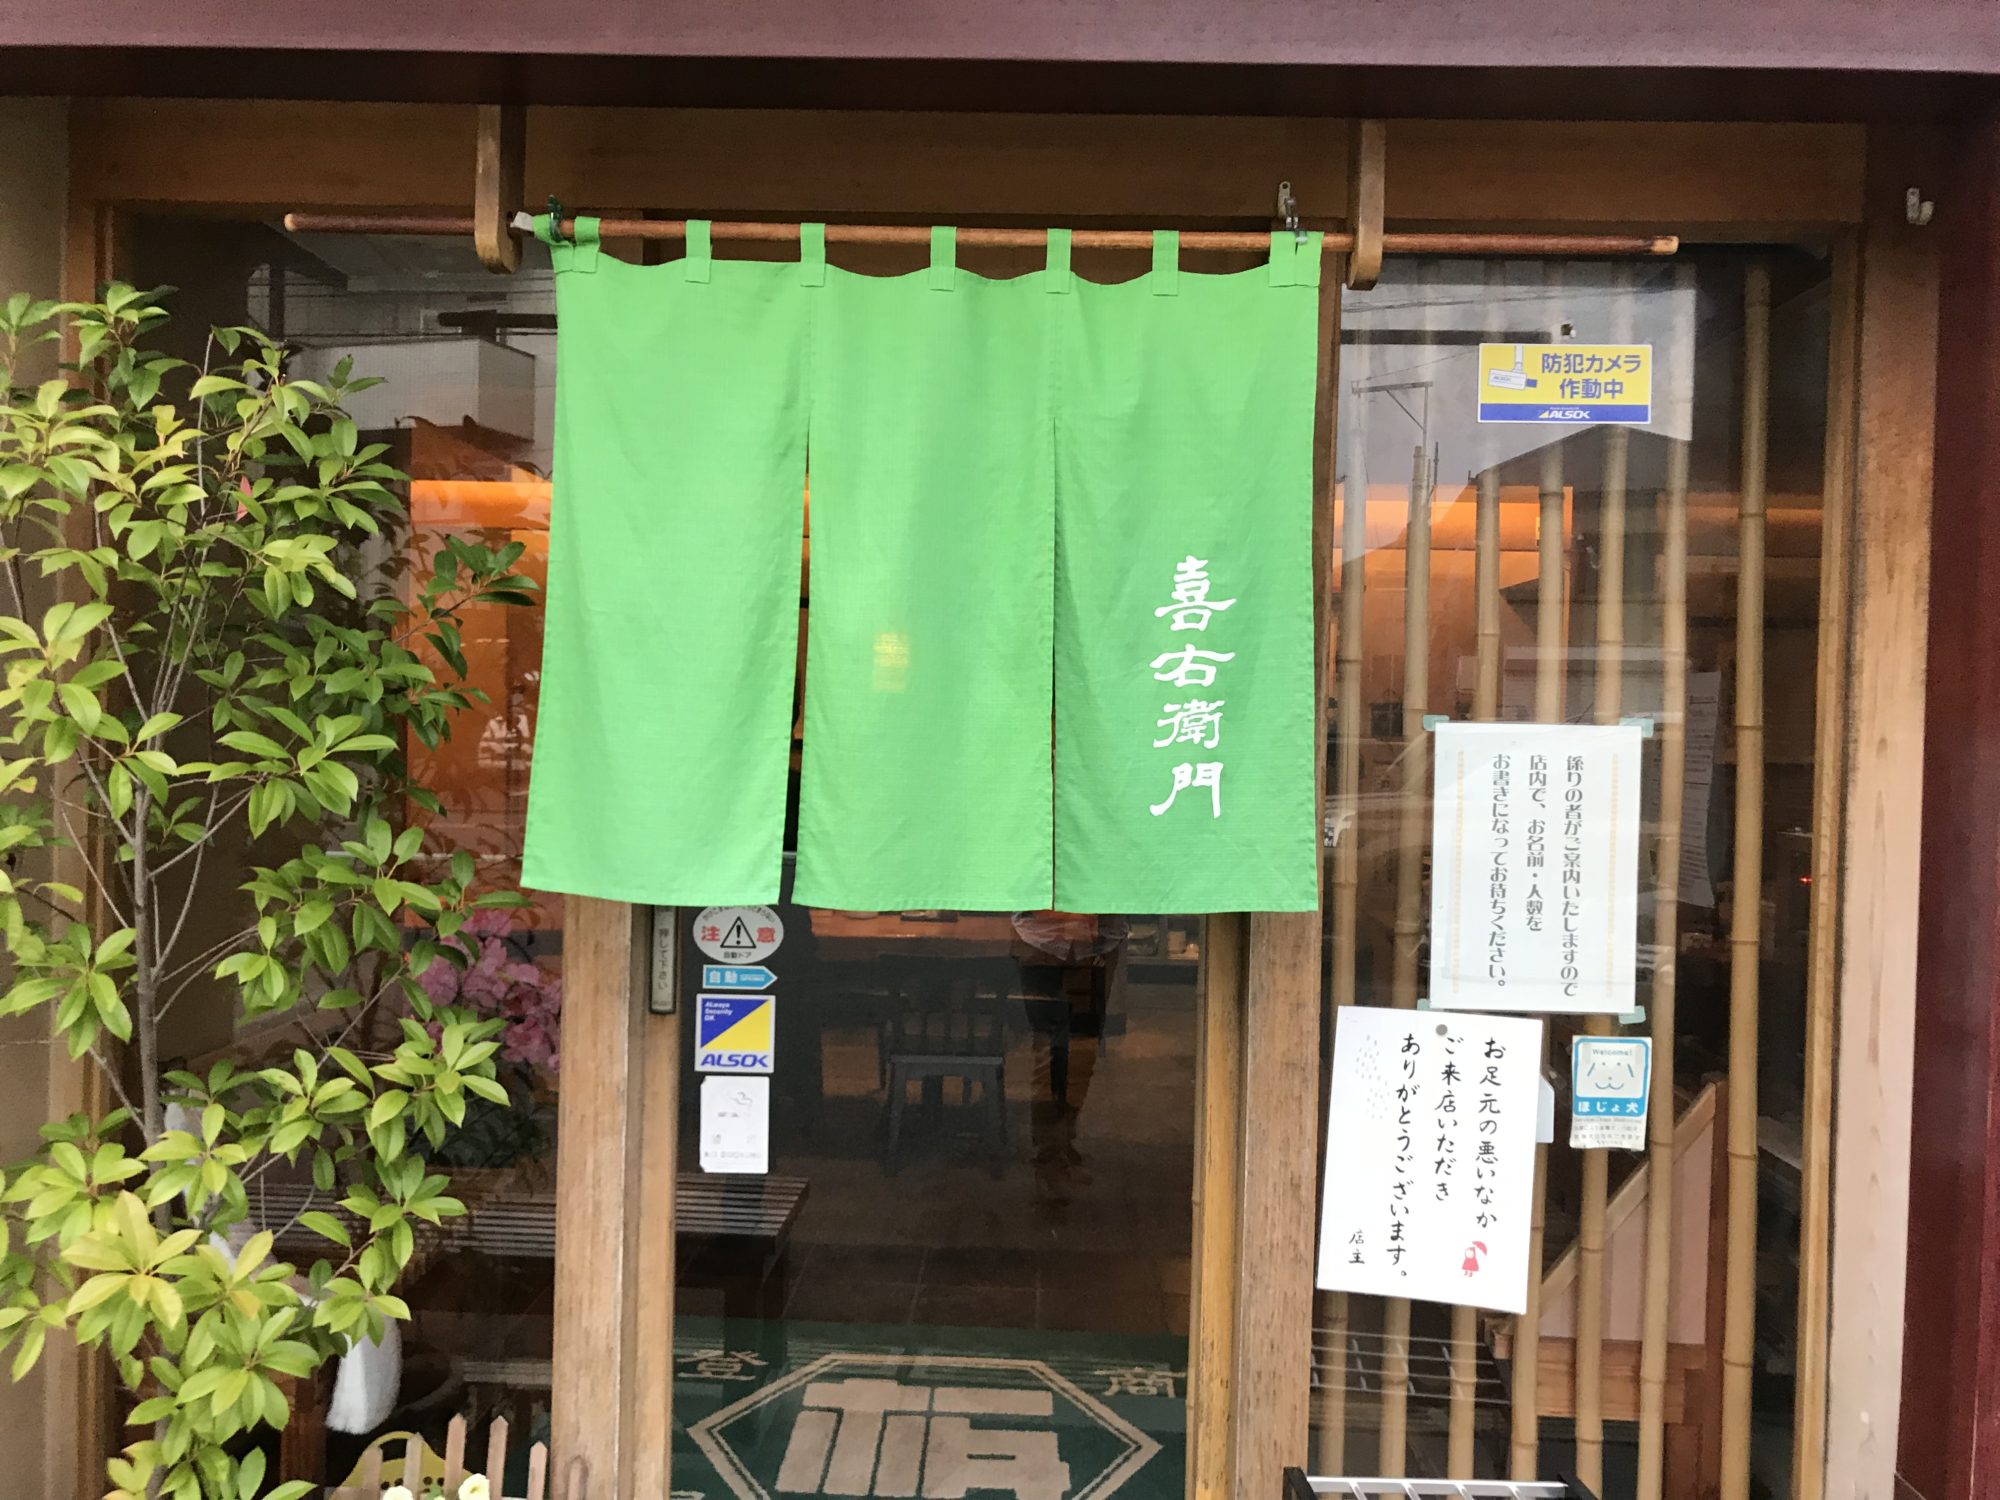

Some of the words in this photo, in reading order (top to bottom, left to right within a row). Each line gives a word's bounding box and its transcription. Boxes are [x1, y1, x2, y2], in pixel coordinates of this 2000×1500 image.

[1541, 353, 1641, 374] 防犯カメラ
[1559, 378, 1624, 399] 作動中
[1549, 410, 1591, 419] ALSOK
[1149, 555, 1237, 819] 喜右衛門
[1489, 753, 1511, 988] お書きになってお待ちください。
[1526, 754, 1547, 932] 店内で、お名前・人数を
[1561, 755, 1584, 997] 係りの者がご案内いたしますので
[700, 1053, 769, 1068] ALSOK
[1592, 1048, 1633, 1056] Welcome!
[1386, 1033, 1421, 1277] ありがとうございます。
[1434, 1035, 1464, 1202] ご来店いただき
[1475, 1037, 1507, 1229] お足元の悪いなか
[1577, 1101, 1639, 1114] ほじょ犬
[1348, 1229, 1366, 1265] 店主
